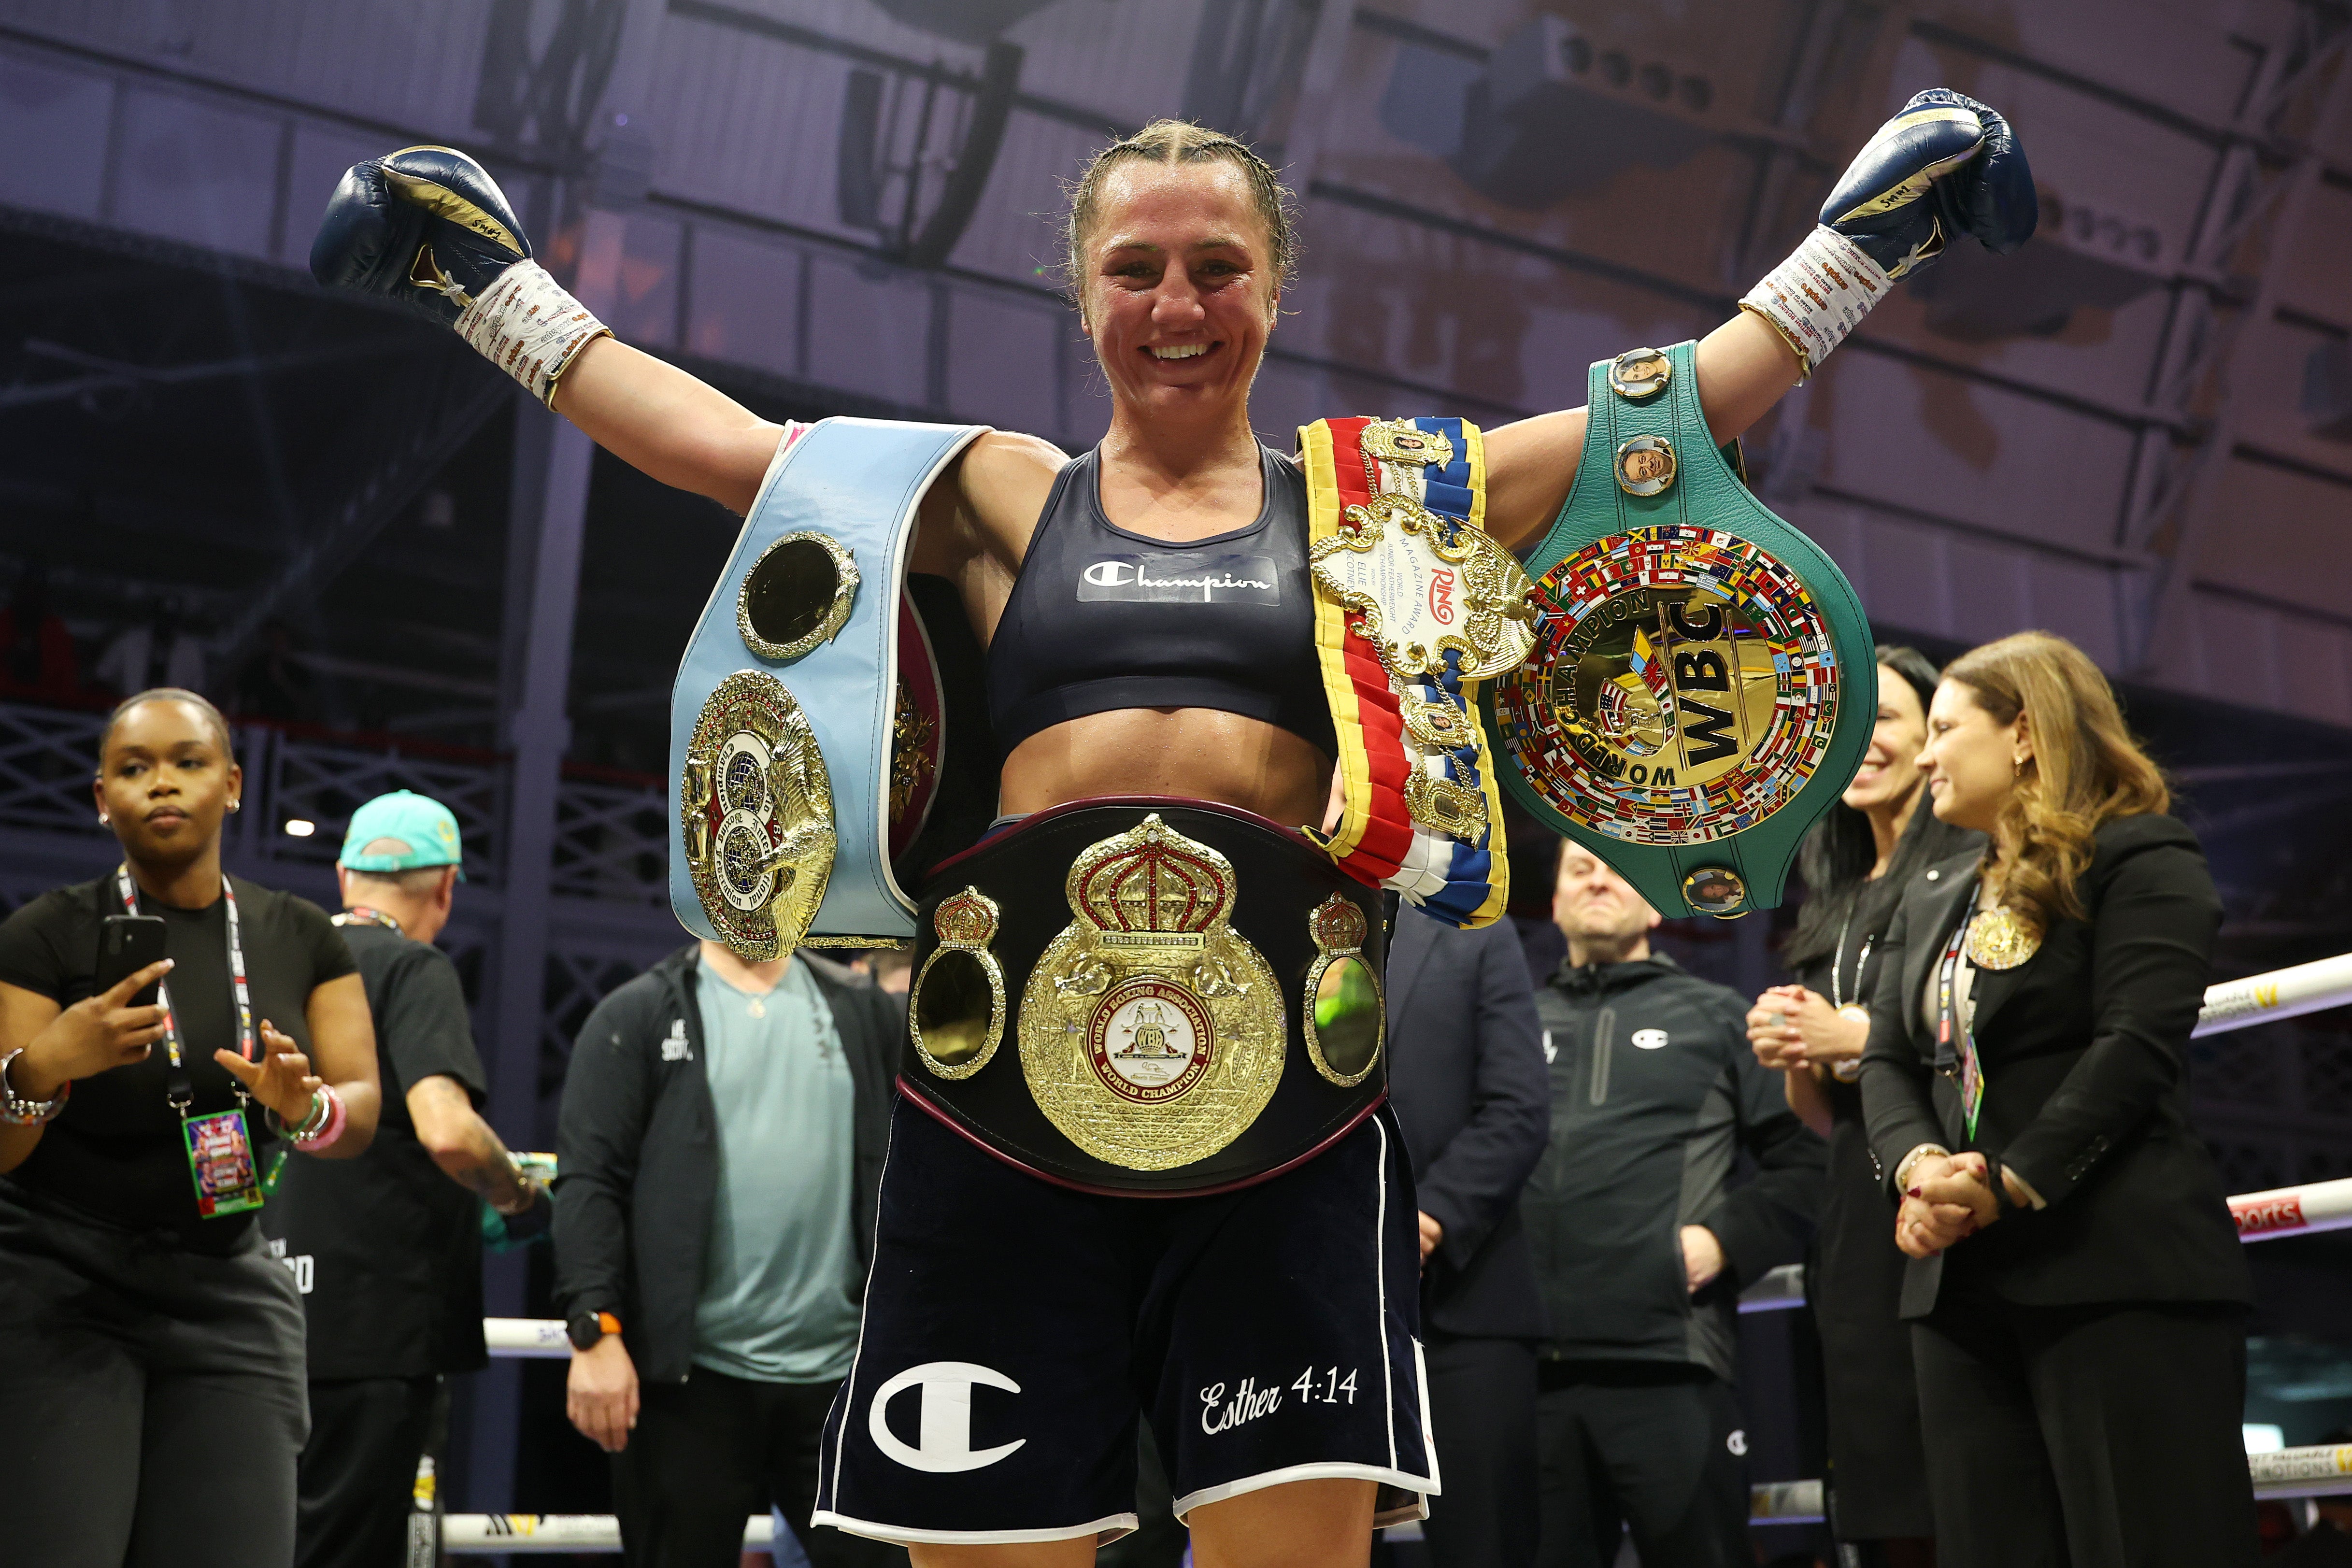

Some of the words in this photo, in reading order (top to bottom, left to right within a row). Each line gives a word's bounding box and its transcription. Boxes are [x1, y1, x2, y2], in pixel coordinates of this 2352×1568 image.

[1812, 276, 1830, 295] BRITISH
[1820, 261, 1849, 291] empire
[1820, 278, 1833, 291] BOARD
[1777, 303, 1795, 320] BOXING
[1799, 282, 1828, 311] empire
[1799, 299, 1813, 312] BOARD
[498, 337, 510, 354] BRITISH
[540, 316, 574, 344] protape
[1794, 319, 1812, 338] BRITISH
[506, 341, 525, 366] empire
[1083, 561, 1271, 602] Champion
[1346, 551, 1355, 591] SCOTNEY
[1357, 562, 1367, 586] ELLIE
[1399, 538, 1424, 599] MAGAZINE
[1429, 568, 1454, 625] RING
[1402, 600, 1423, 634] AWARD
[1554, 589, 1651, 725] CHAMPION
[1668, 602, 1740, 767] WBC
[1575, 732, 1676, 786] WORLD
[718, 742, 735, 813] Champion
[718, 810, 743, 844] Boxing
[715, 847, 742, 907] Federation
[749, 817, 771, 908] Intertional
[1094, 1009, 1111, 1055] WORLD
[1109, 986, 1155, 1010] BOXING
[1156, 988, 1207, 1055] ASSOCIATION
[1138, 1030, 1163, 1046] WBA
[1101, 1062, 1139, 1096] WORLD
[1141, 1062, 1201, 1098] CHAMPION
[1200, 1377, 1282, 1435] Esther
[1291, 1365, 1358, 1404] 4:14
